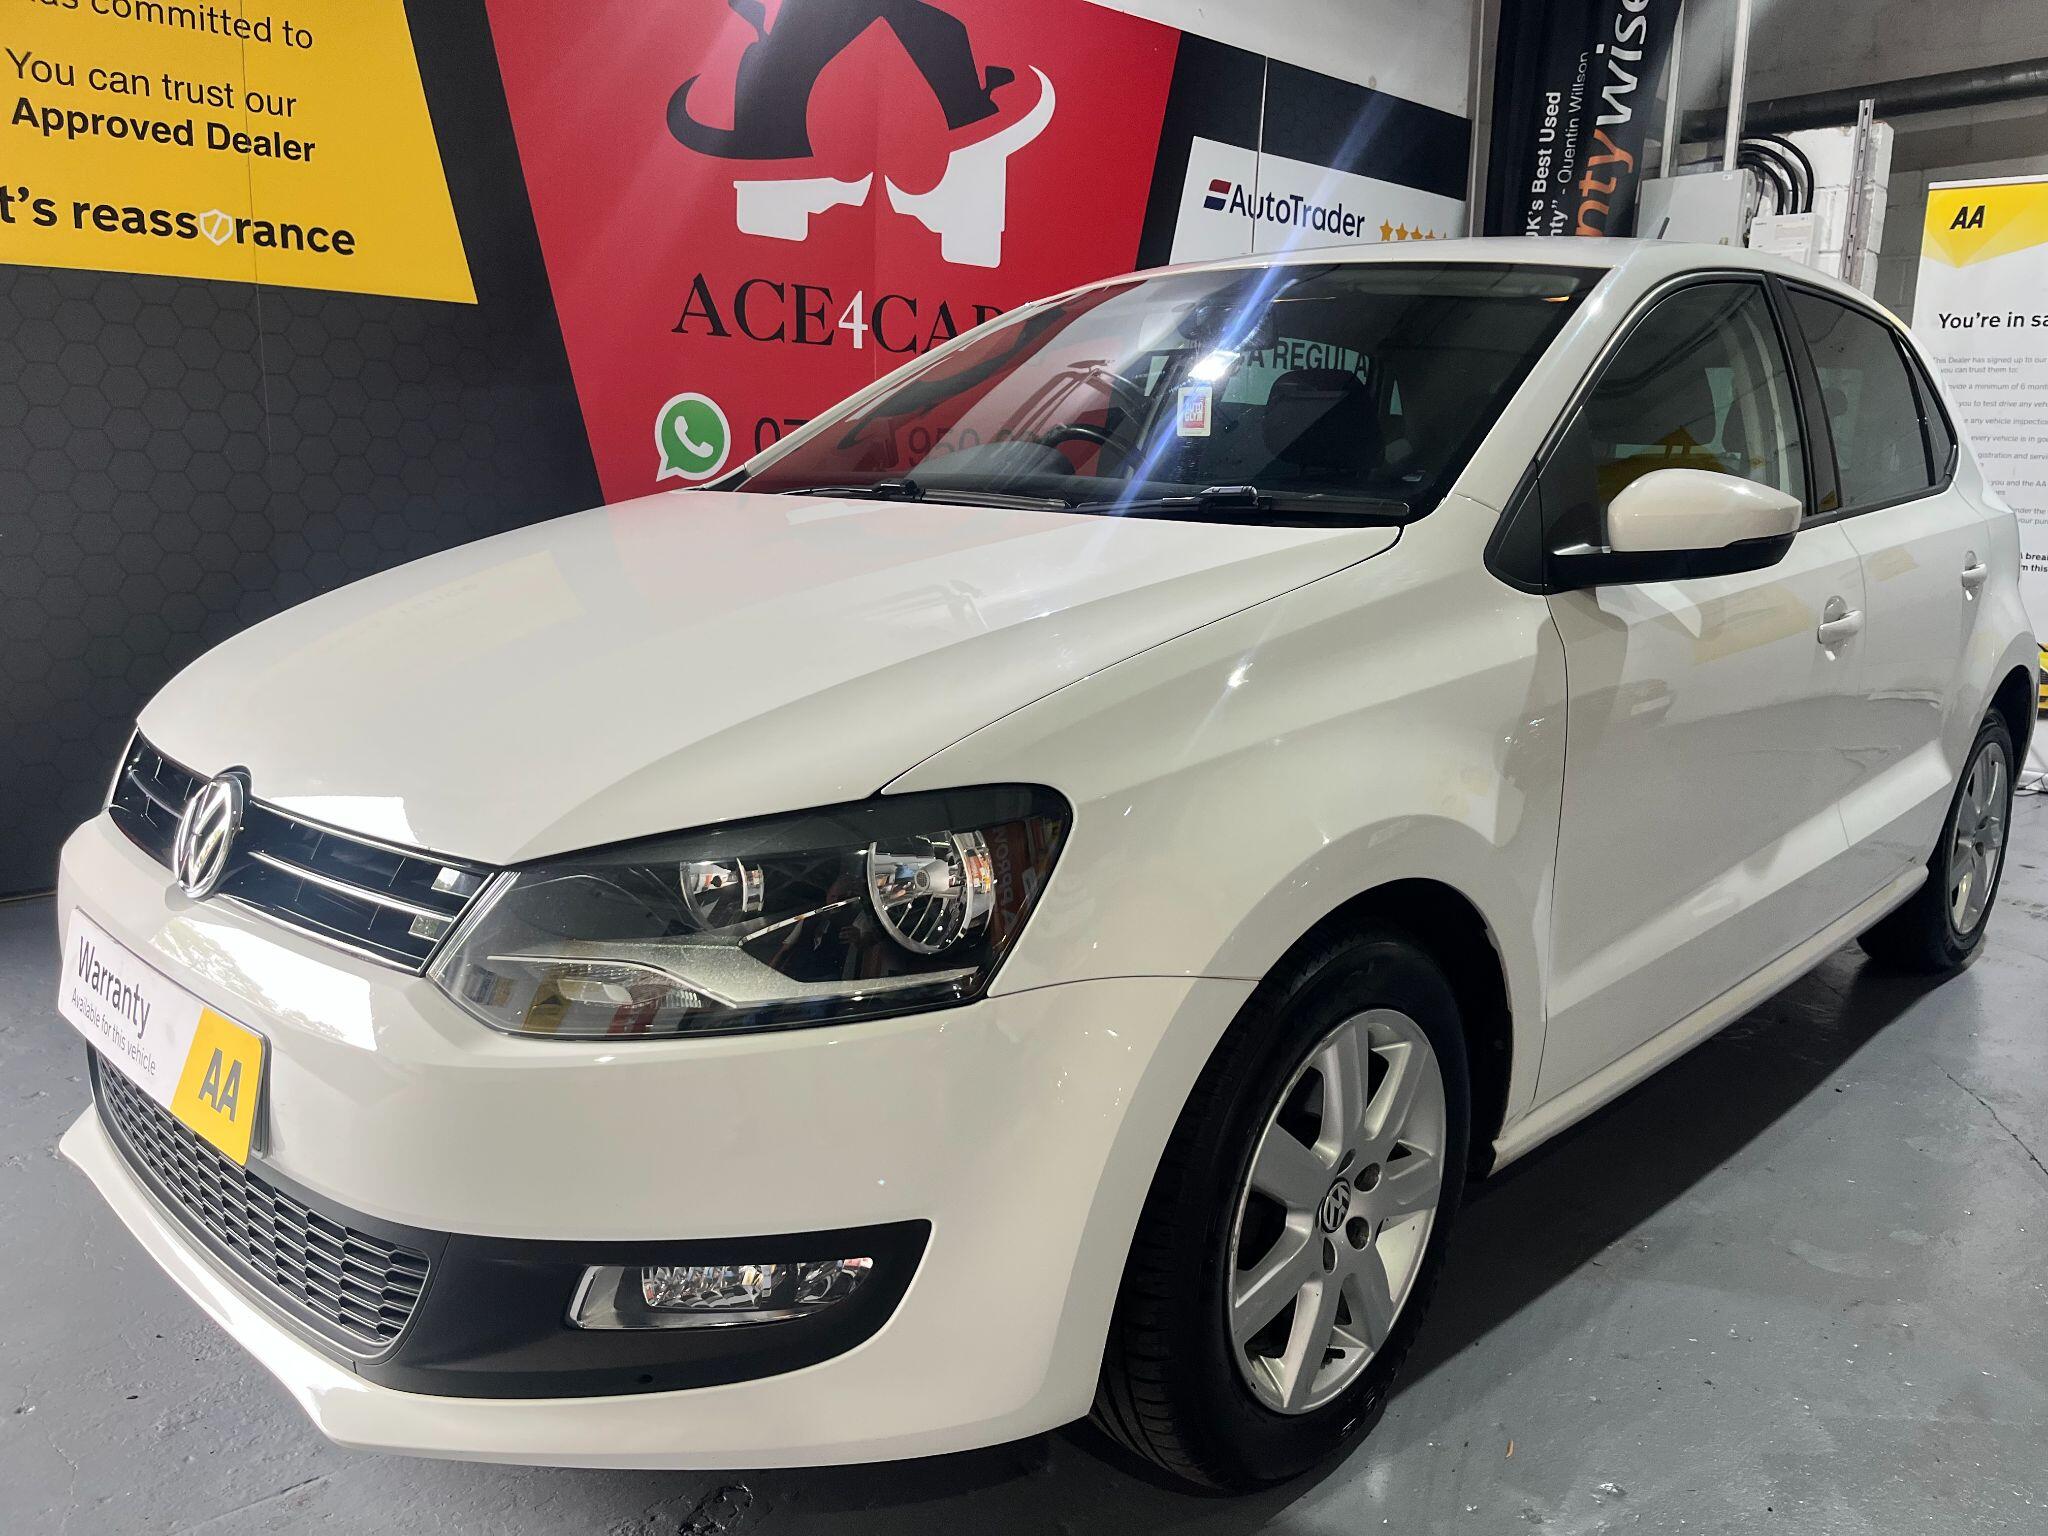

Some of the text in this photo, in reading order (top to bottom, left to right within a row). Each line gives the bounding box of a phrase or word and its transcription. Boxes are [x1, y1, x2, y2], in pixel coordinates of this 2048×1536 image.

[91, 0, 314, 49] committed to
[5, 47, 297, 118] You can trust our
[1568, 52, 1589, 113] Willson
[11, 97, 316, 163] Approved Dealer
[1539, 91, 1561, 143] Used
[1532, 149, 1553, 193] Best
[1557, 117, 1580, 184] Quentin
[1228, 184, 1366, 239] AutoTrader
[1949, 205, 1986, 230] AA
[1938, 312, 2001, 329] You're
[2006, 311, 2025, 328] in
[78, 935, 151, 1040] Warranty
[71, 987, 157, 1076] Available for this vehicle
[197, 1047, 243, 1124] AA
